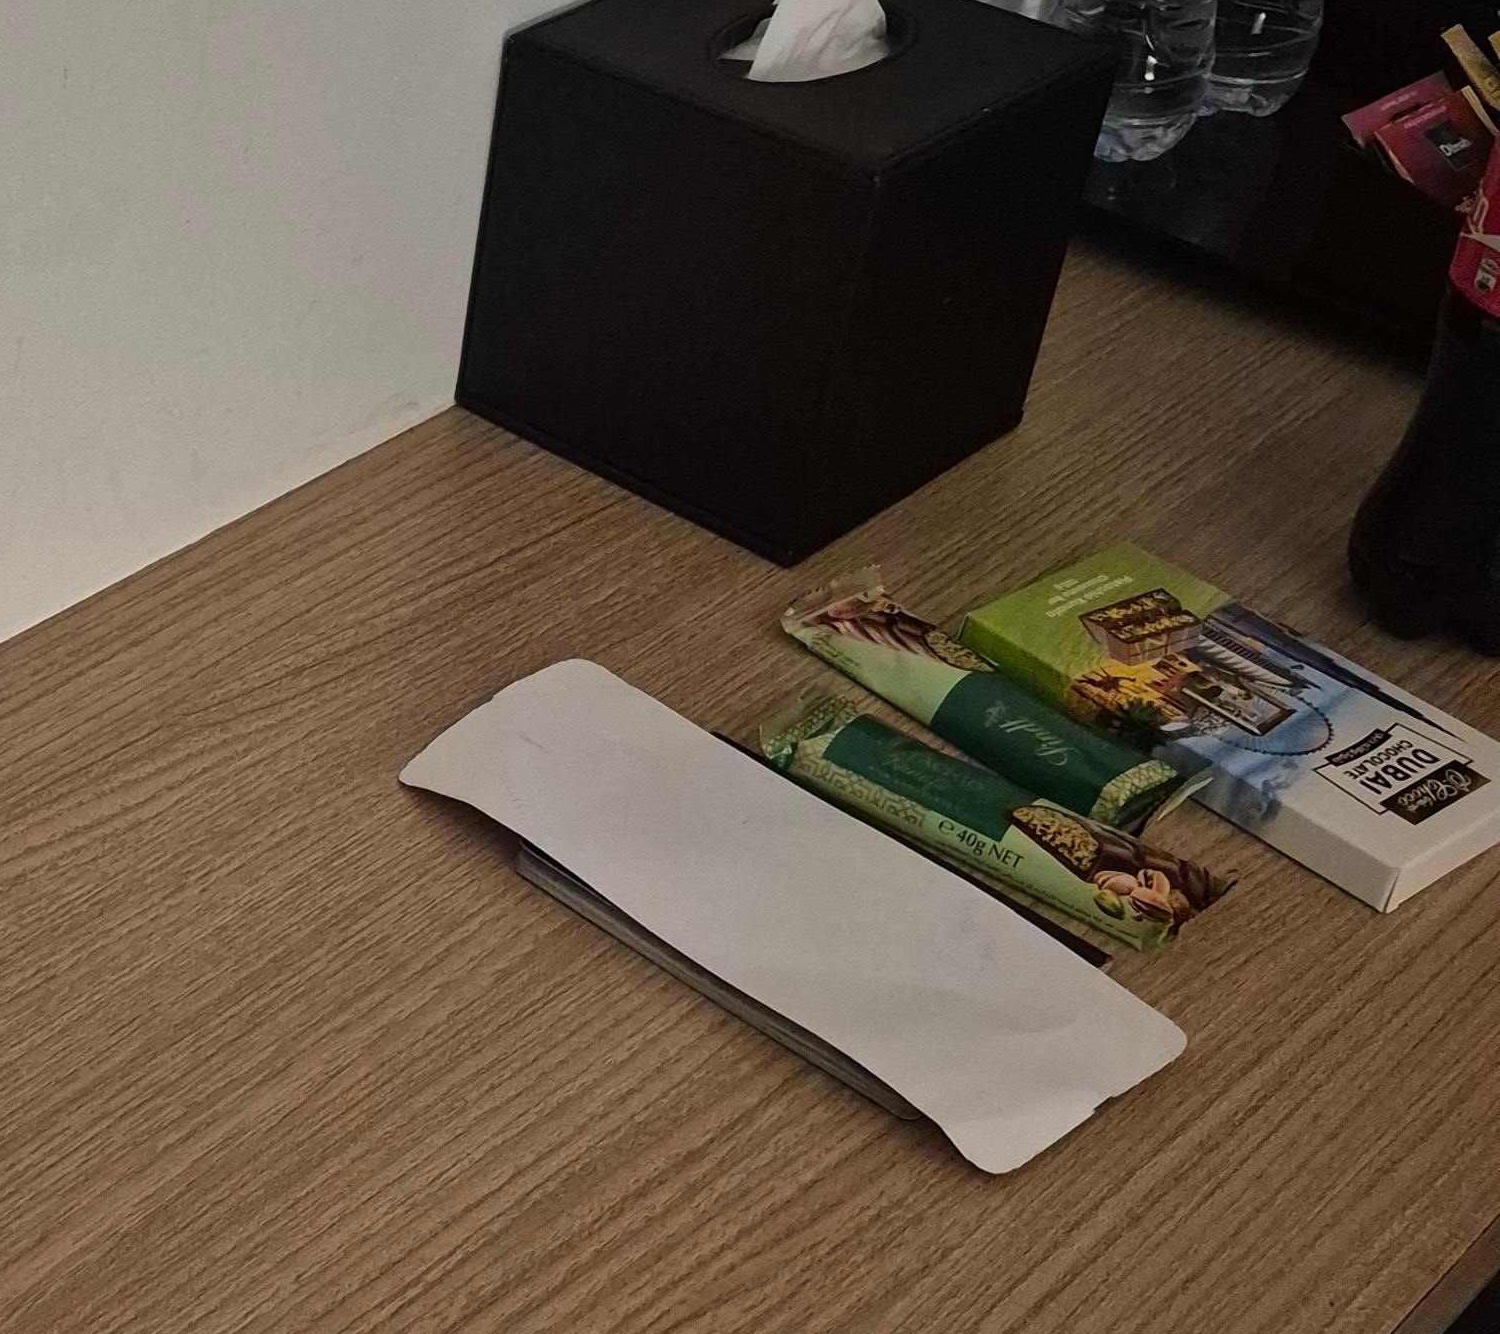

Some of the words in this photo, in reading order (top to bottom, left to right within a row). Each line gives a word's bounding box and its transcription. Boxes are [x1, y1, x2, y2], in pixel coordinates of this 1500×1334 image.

[998, 716, 1076, 767] Lindt
[1344, 739, 1414, 781] CHOCOLATE
[1359, 747, 1442, 796] DUBAI
[955, 828, 987, 857] 40g
[987, 843, 1025, 869] NET
